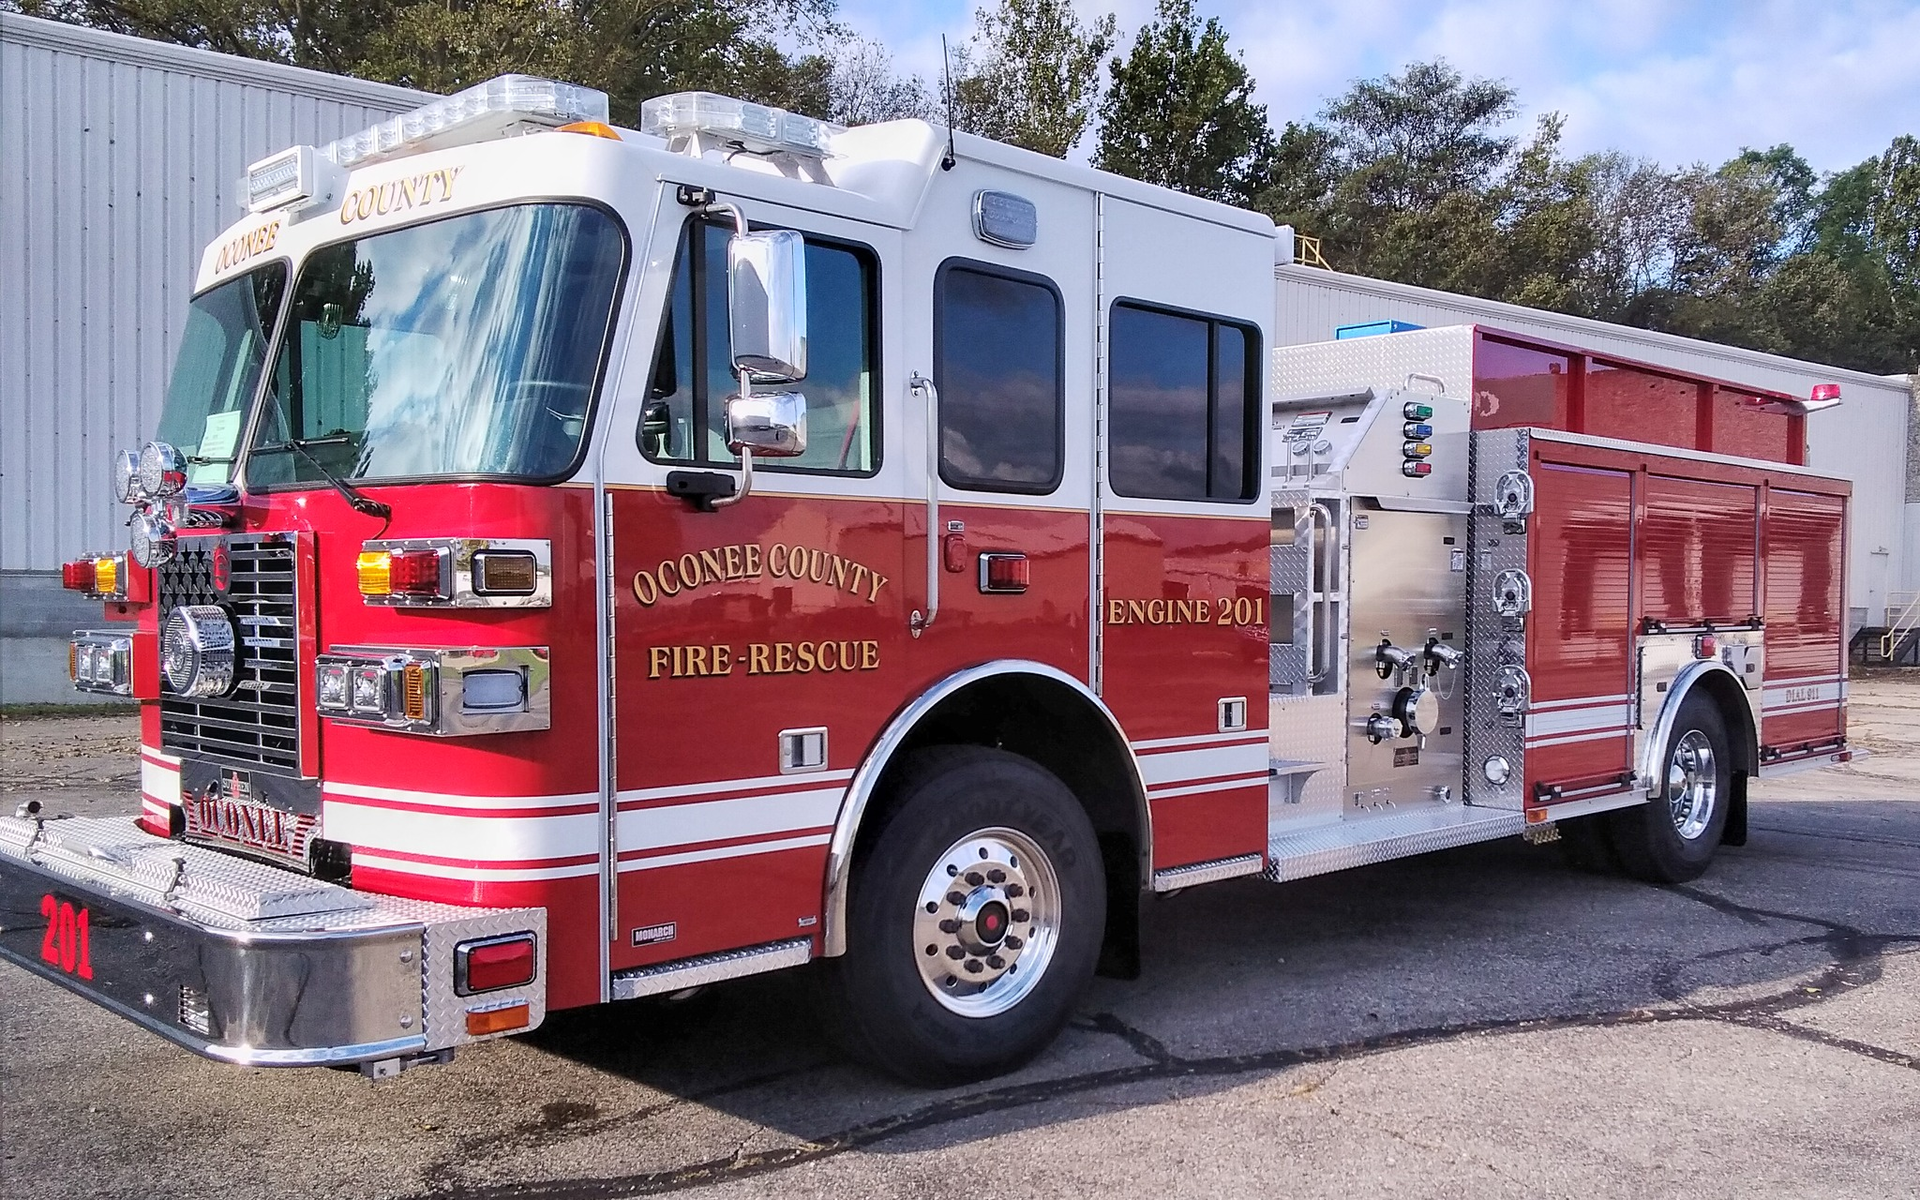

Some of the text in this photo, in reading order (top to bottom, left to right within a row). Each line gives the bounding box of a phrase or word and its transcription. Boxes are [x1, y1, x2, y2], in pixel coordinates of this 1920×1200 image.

[214, 165, 466, 275] OCONEE COUNTY
[632, 542, 890, 608] OCONEE COUNTY
[1107, 596, 1265, 627] ENGINE 201
[40, 893, 94, 981] 201
[635, 924, 674, 942] MONARCH
